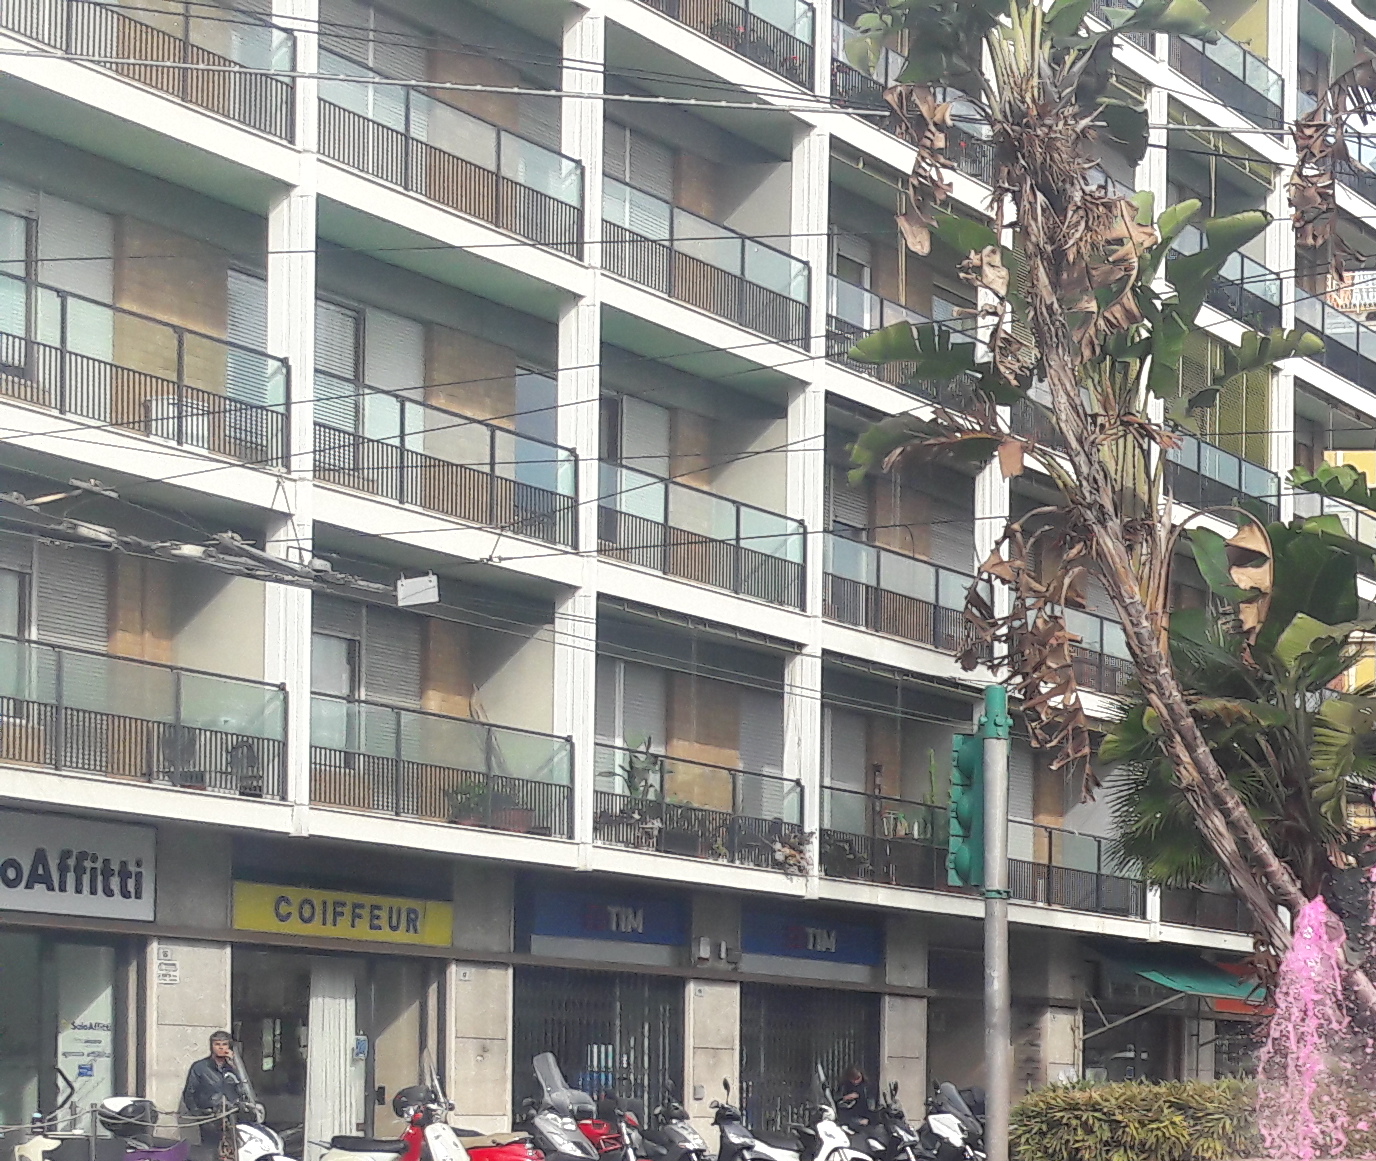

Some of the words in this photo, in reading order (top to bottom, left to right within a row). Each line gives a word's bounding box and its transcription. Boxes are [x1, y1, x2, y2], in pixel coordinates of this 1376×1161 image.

[274, 895, 420, 935] COIFFEUR
[607, 905, 643, 933] TIM
[805, 928, 836, 952] TIM
